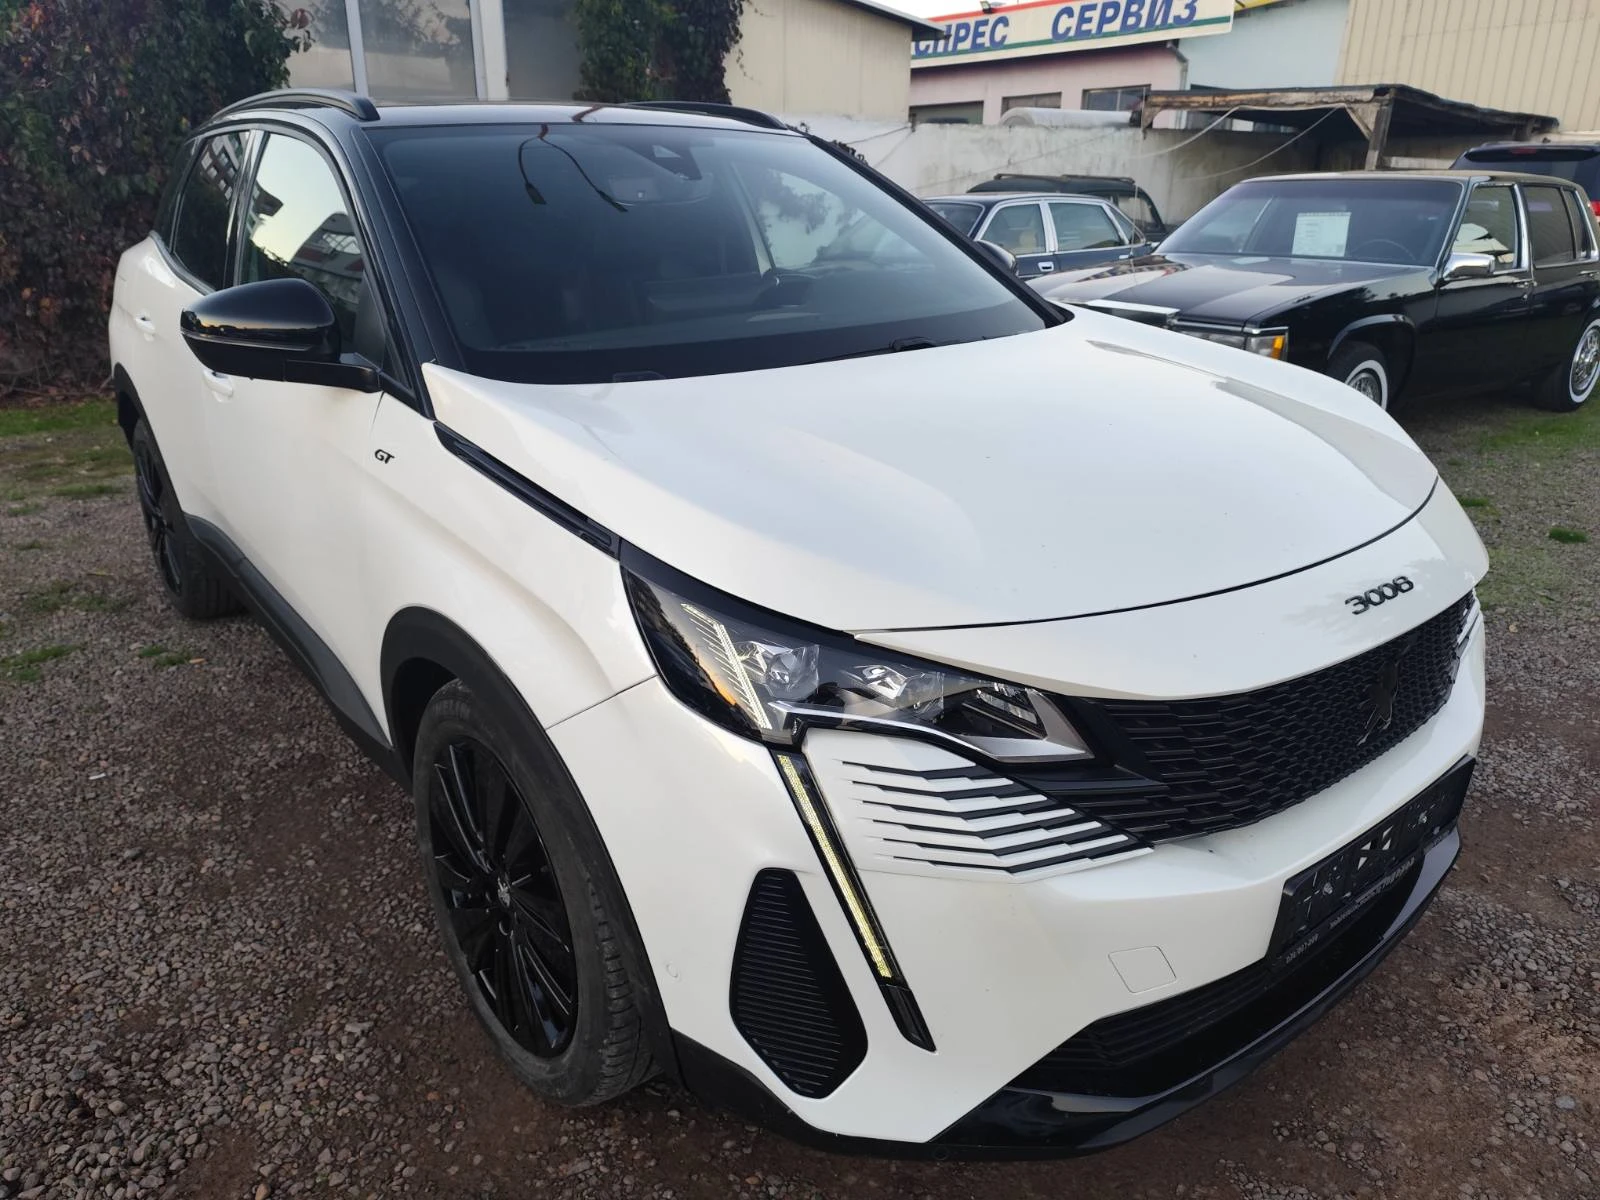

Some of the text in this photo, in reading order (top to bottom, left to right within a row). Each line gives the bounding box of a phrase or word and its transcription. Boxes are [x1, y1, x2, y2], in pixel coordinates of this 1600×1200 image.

[1051, 0, 1197, 42] СЕРВИЗ
[374, 449, 395, 464] GT
[1344, 575, 1414, 615] 3008
